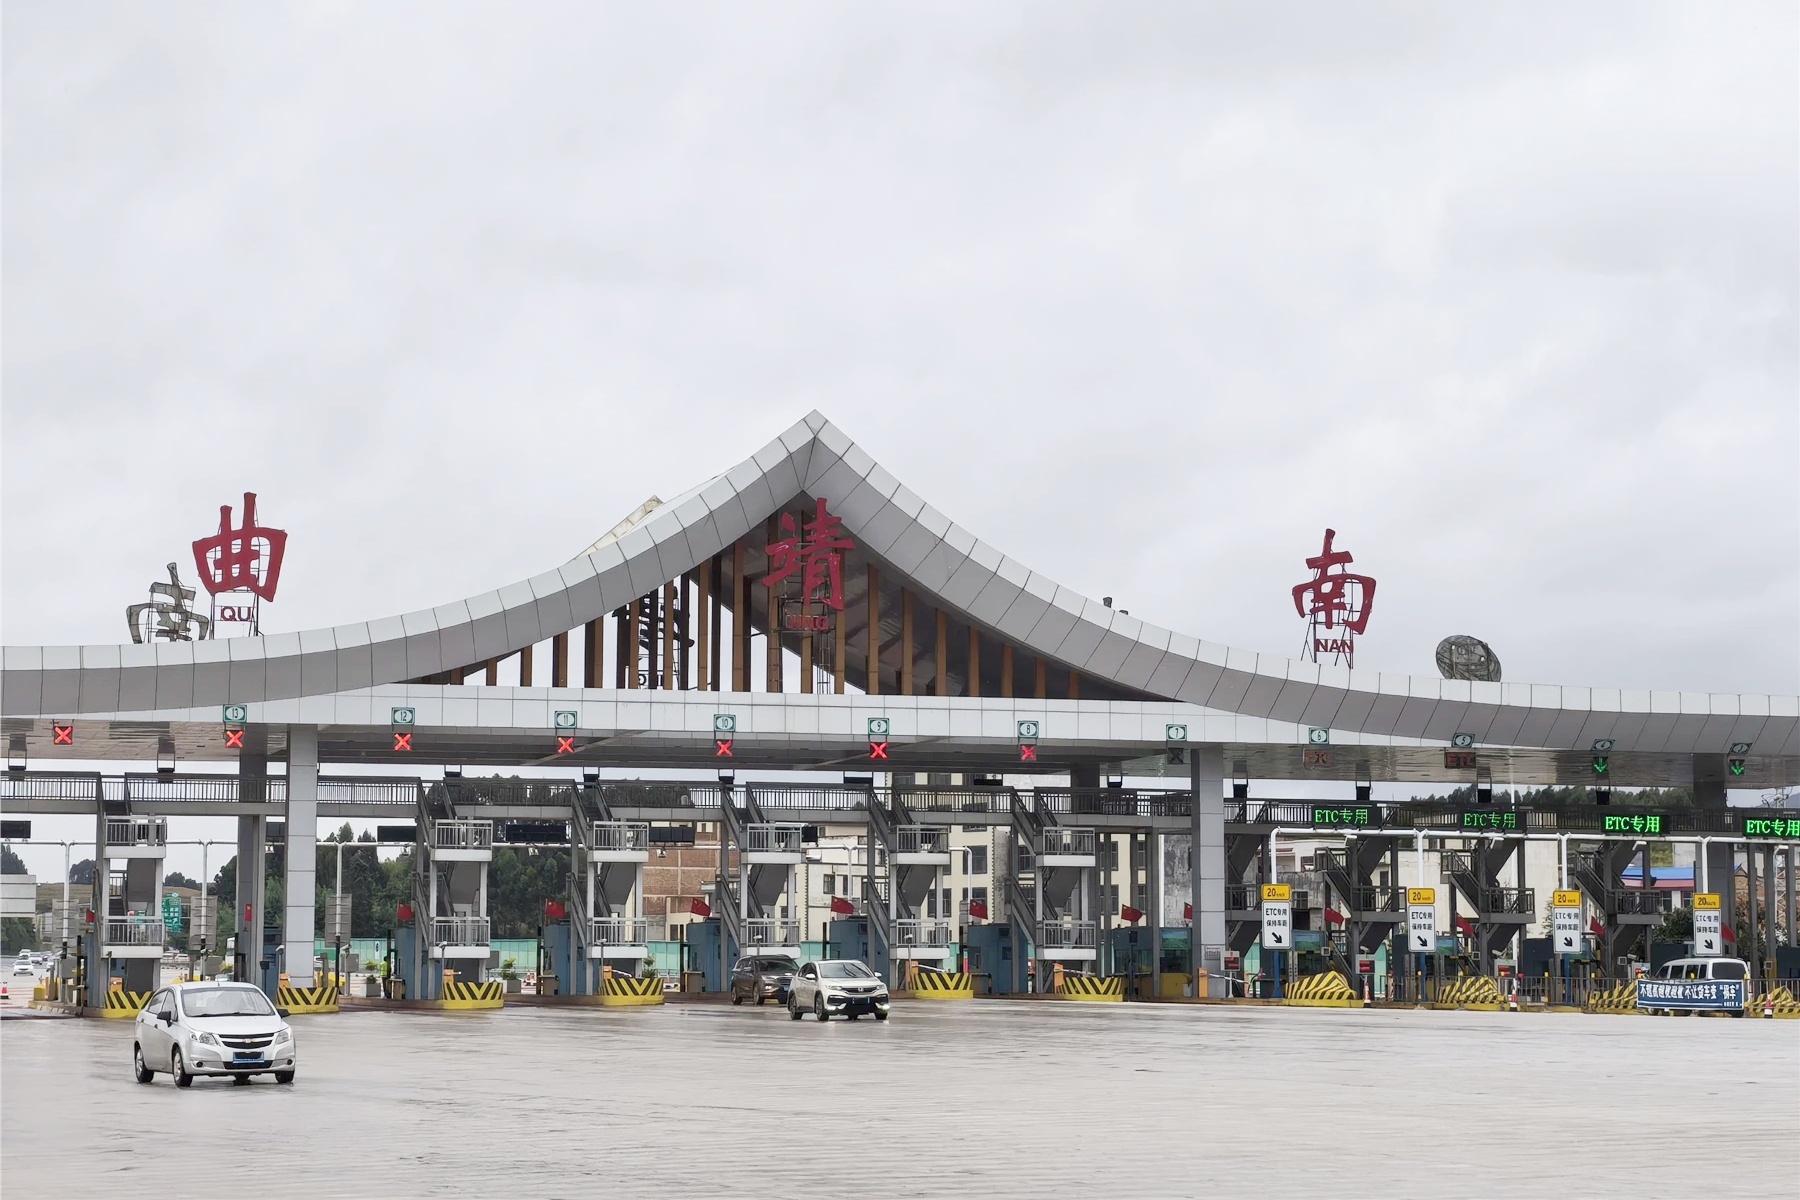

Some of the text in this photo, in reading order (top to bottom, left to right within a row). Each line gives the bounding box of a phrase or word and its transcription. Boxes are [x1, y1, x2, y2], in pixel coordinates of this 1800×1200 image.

[192, 492, 1376, 635] 曲 靖 南
[220, 605, 252, 622] QU
[1315, 639, 1354, 653] NAN
[1314, 808, 1368, 825] ETC专用
[1463, 811, 1516, 828] ETC专用
[1605, 815, 1660, 833] ETC专用
[1746, 819, 1800, 837] ETC专用
[1267, 887, 1277, 897] 20
[1412, 891, 1422, 901] 20
[1557, 894, 1567, 903] 20
[1697, 897, 1707, 906] 20
[1265, 908, 1287, 916] ETC专用
[1411, 911, 1432, 920] ETC专用
